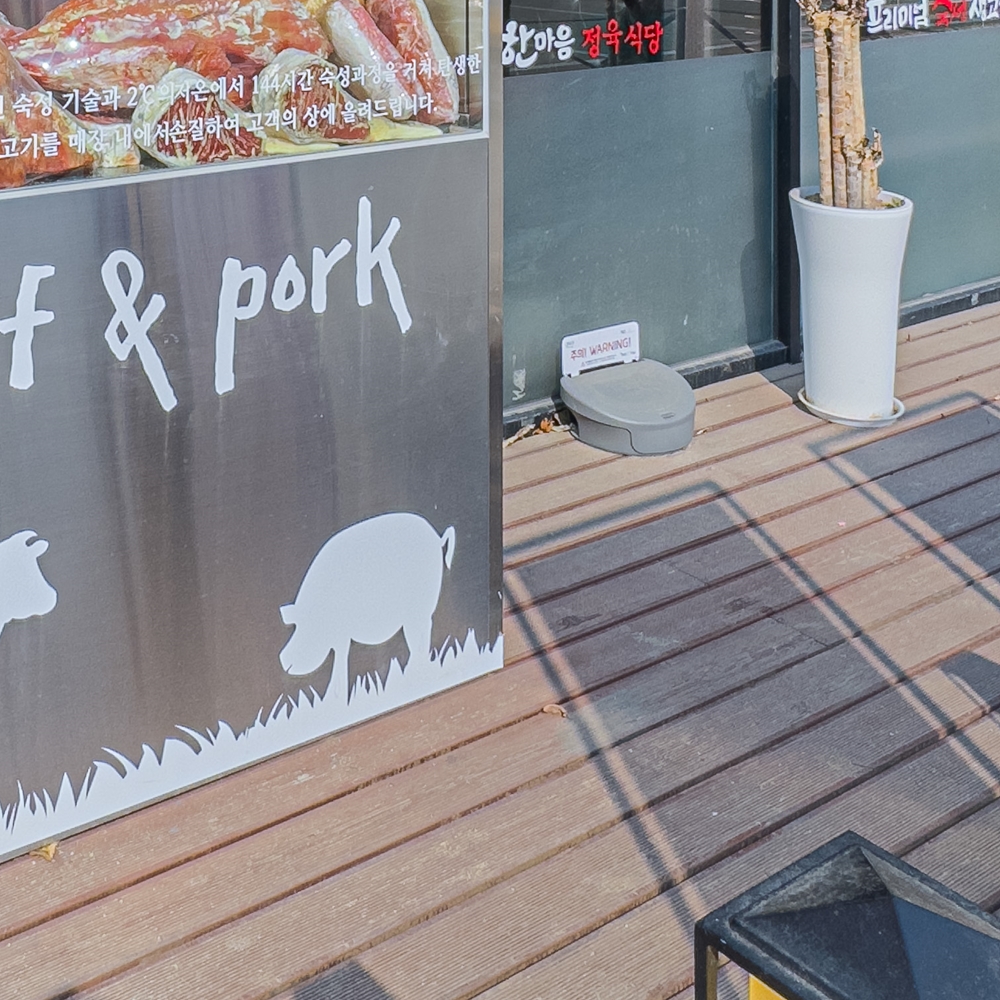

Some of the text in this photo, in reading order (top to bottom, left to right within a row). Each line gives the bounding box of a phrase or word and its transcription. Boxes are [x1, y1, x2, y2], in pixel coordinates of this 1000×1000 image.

[502, 18, 664, 68] 한마음 정육식당
[62, 86, 120, 114] 기술과
[252, 69, 313, 95] 144시간
[246, 106, 297, 132] 고객의
[303, 104, 335, 129] 상에
[101, 249, 178, 412] &
[214, 195, 412, 395] pork
